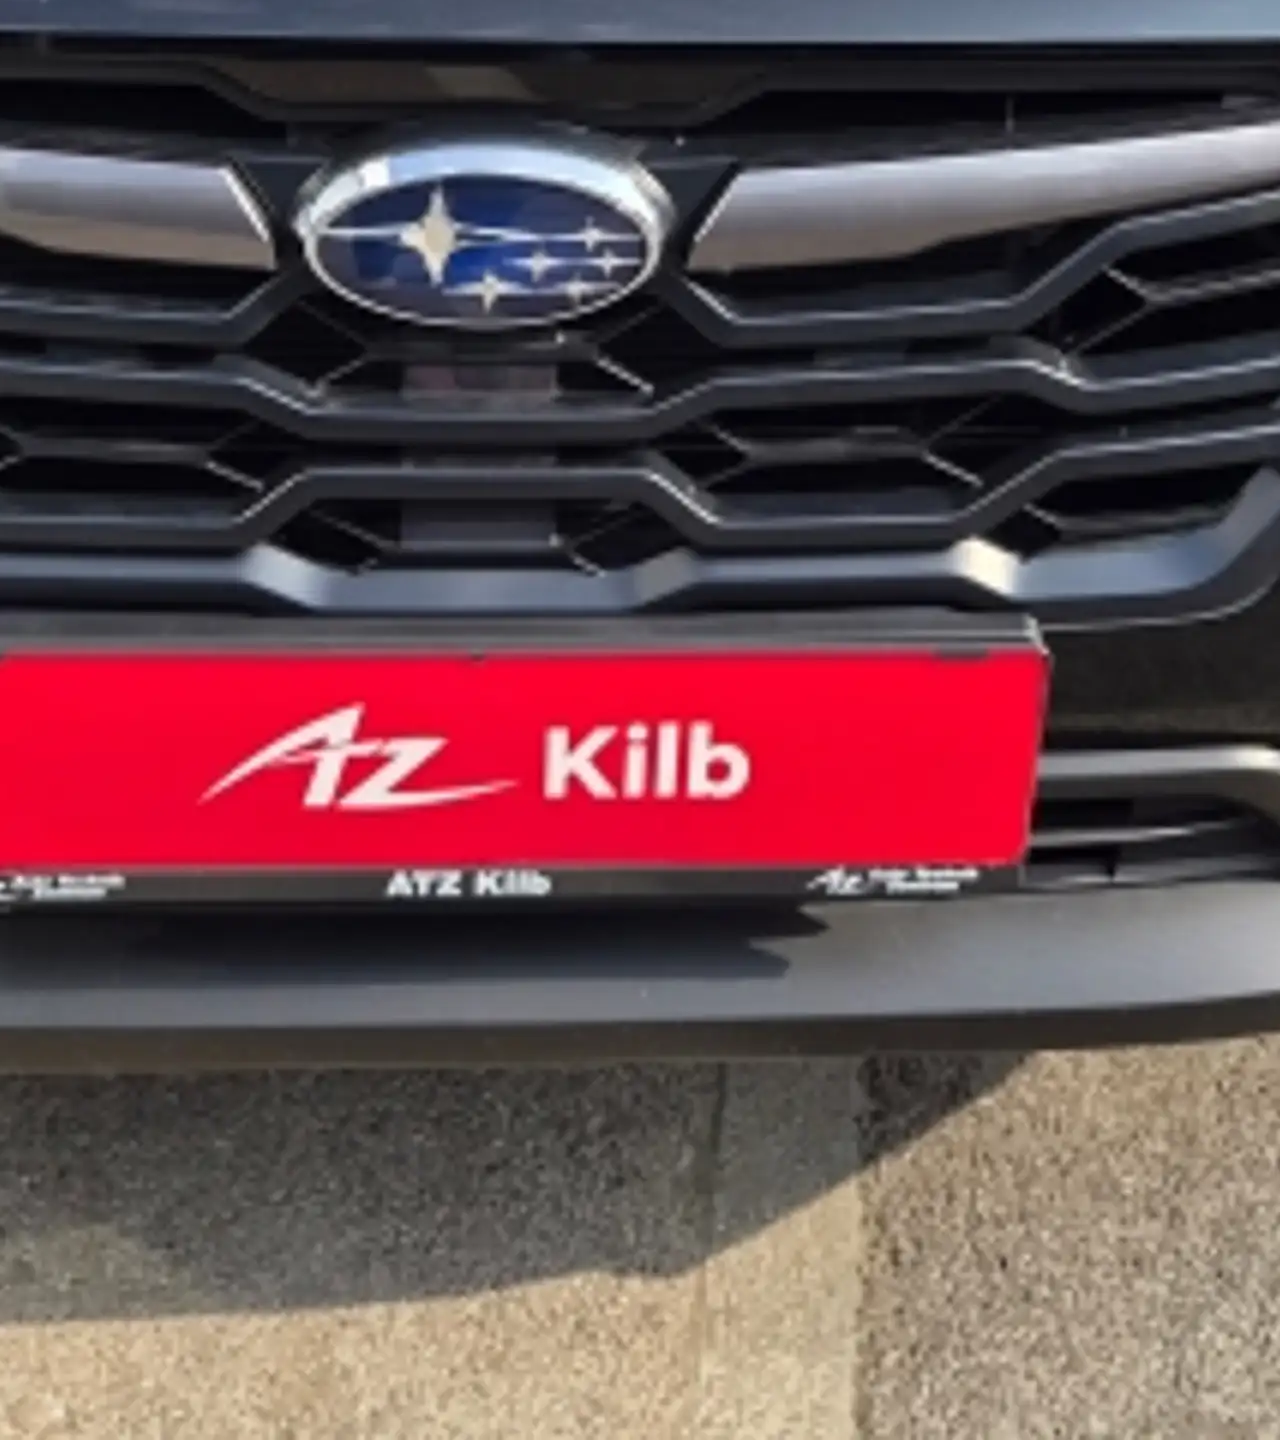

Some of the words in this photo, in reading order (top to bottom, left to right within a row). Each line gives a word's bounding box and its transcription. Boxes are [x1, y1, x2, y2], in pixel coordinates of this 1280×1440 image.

[543, 721, 751, 801] Kilb
[387, 869, 462, 897] ATZ
[475, 869, 552, 897] Kilb
